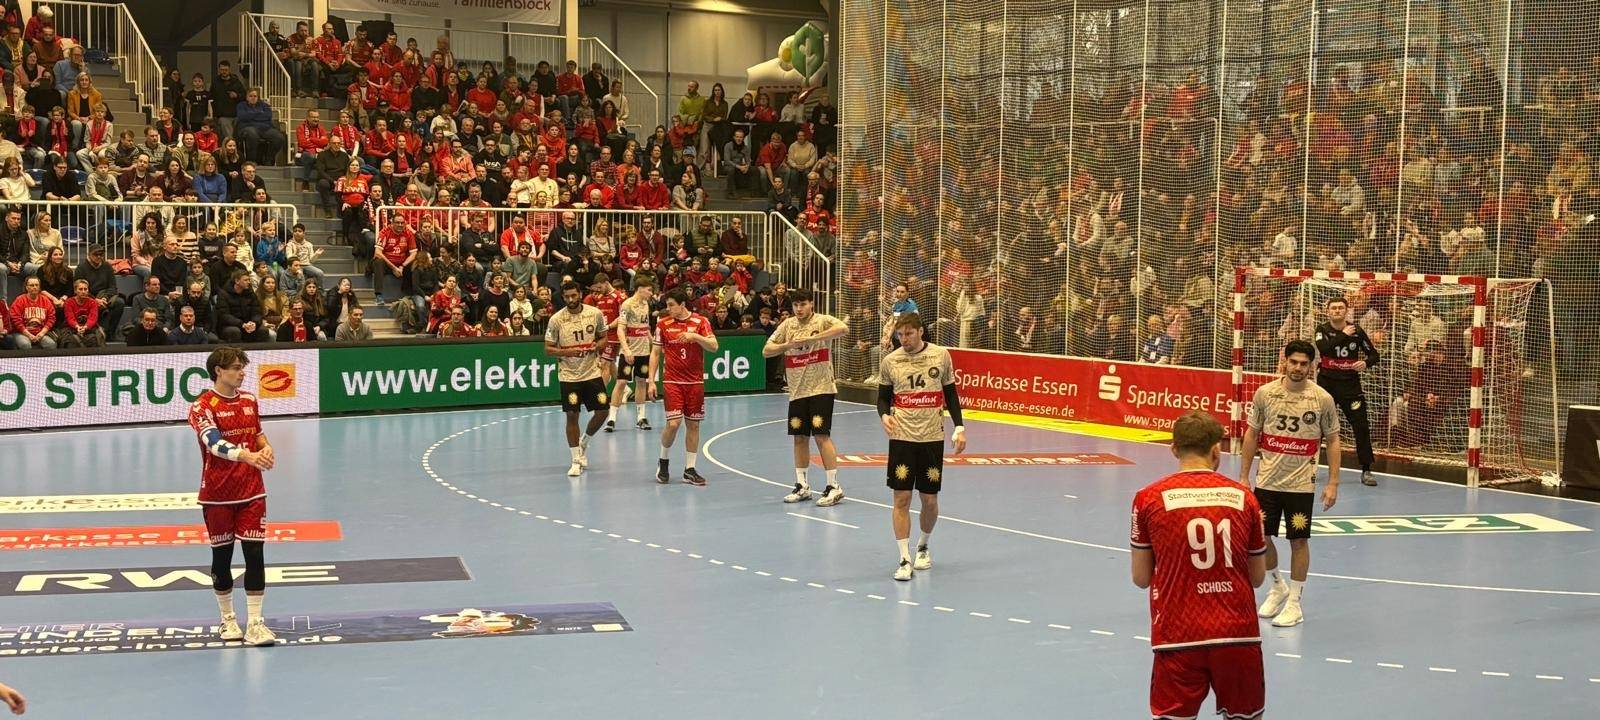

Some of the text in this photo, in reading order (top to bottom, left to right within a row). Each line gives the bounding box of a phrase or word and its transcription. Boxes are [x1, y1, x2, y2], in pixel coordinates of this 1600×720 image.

[573, 330, 584, 342] 11
[680, 348, 687, 359] 3
[1335, 346, 1349, 357] 16
[45, 367, 210, 409] STRUC
[907, 373, 926, 389] 14
[955, 369, 1078, 397] Sparkasse Essen
[1127, 384, 1209, 411] Sparkasse
[1276, 414, 1300, 432] 33
[1186, 517, 1234, 570] 91
[15, 565, 340, 592] RWE
[1196, 581, 1234, 594] SCHOSS
